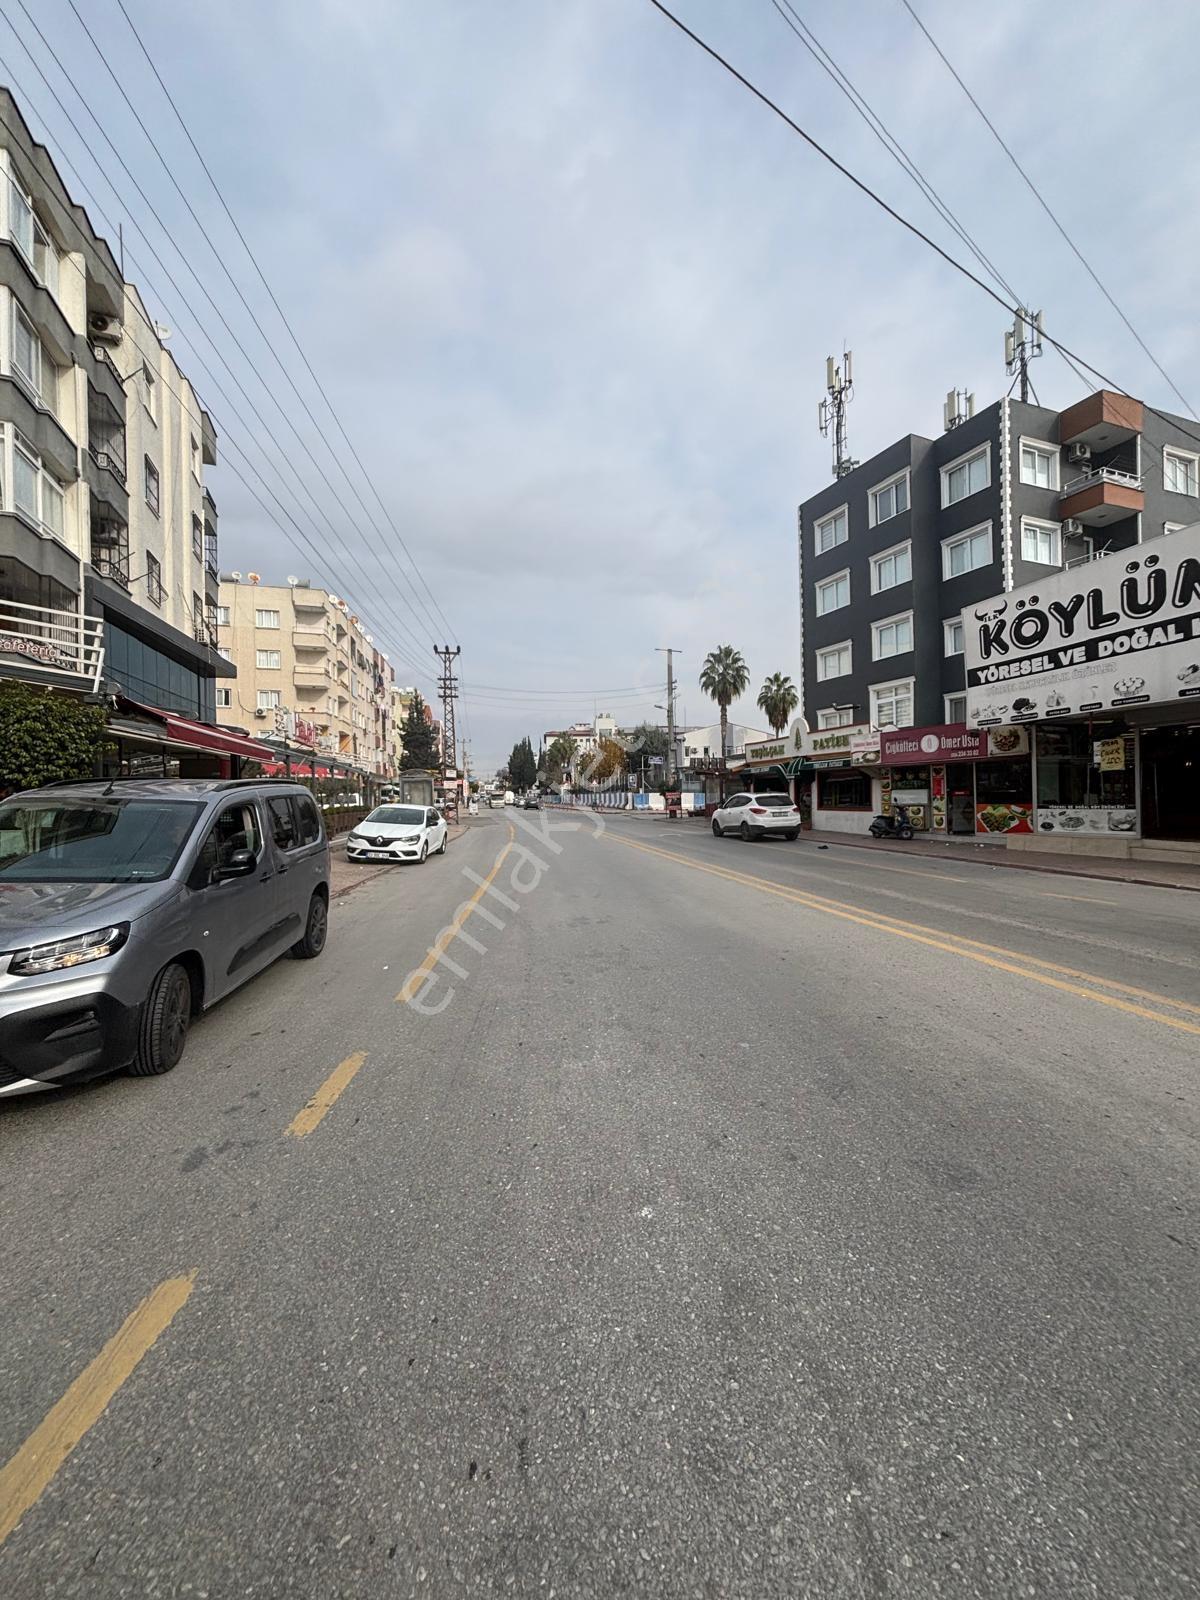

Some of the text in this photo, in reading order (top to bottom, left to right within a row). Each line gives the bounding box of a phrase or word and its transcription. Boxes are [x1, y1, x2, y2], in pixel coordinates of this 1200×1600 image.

[977, 655, 1055, 684] YÖRESEL
[1058, 646, 1087, 667] VE
[1098, 624, 1184, 657] DOĞAL
